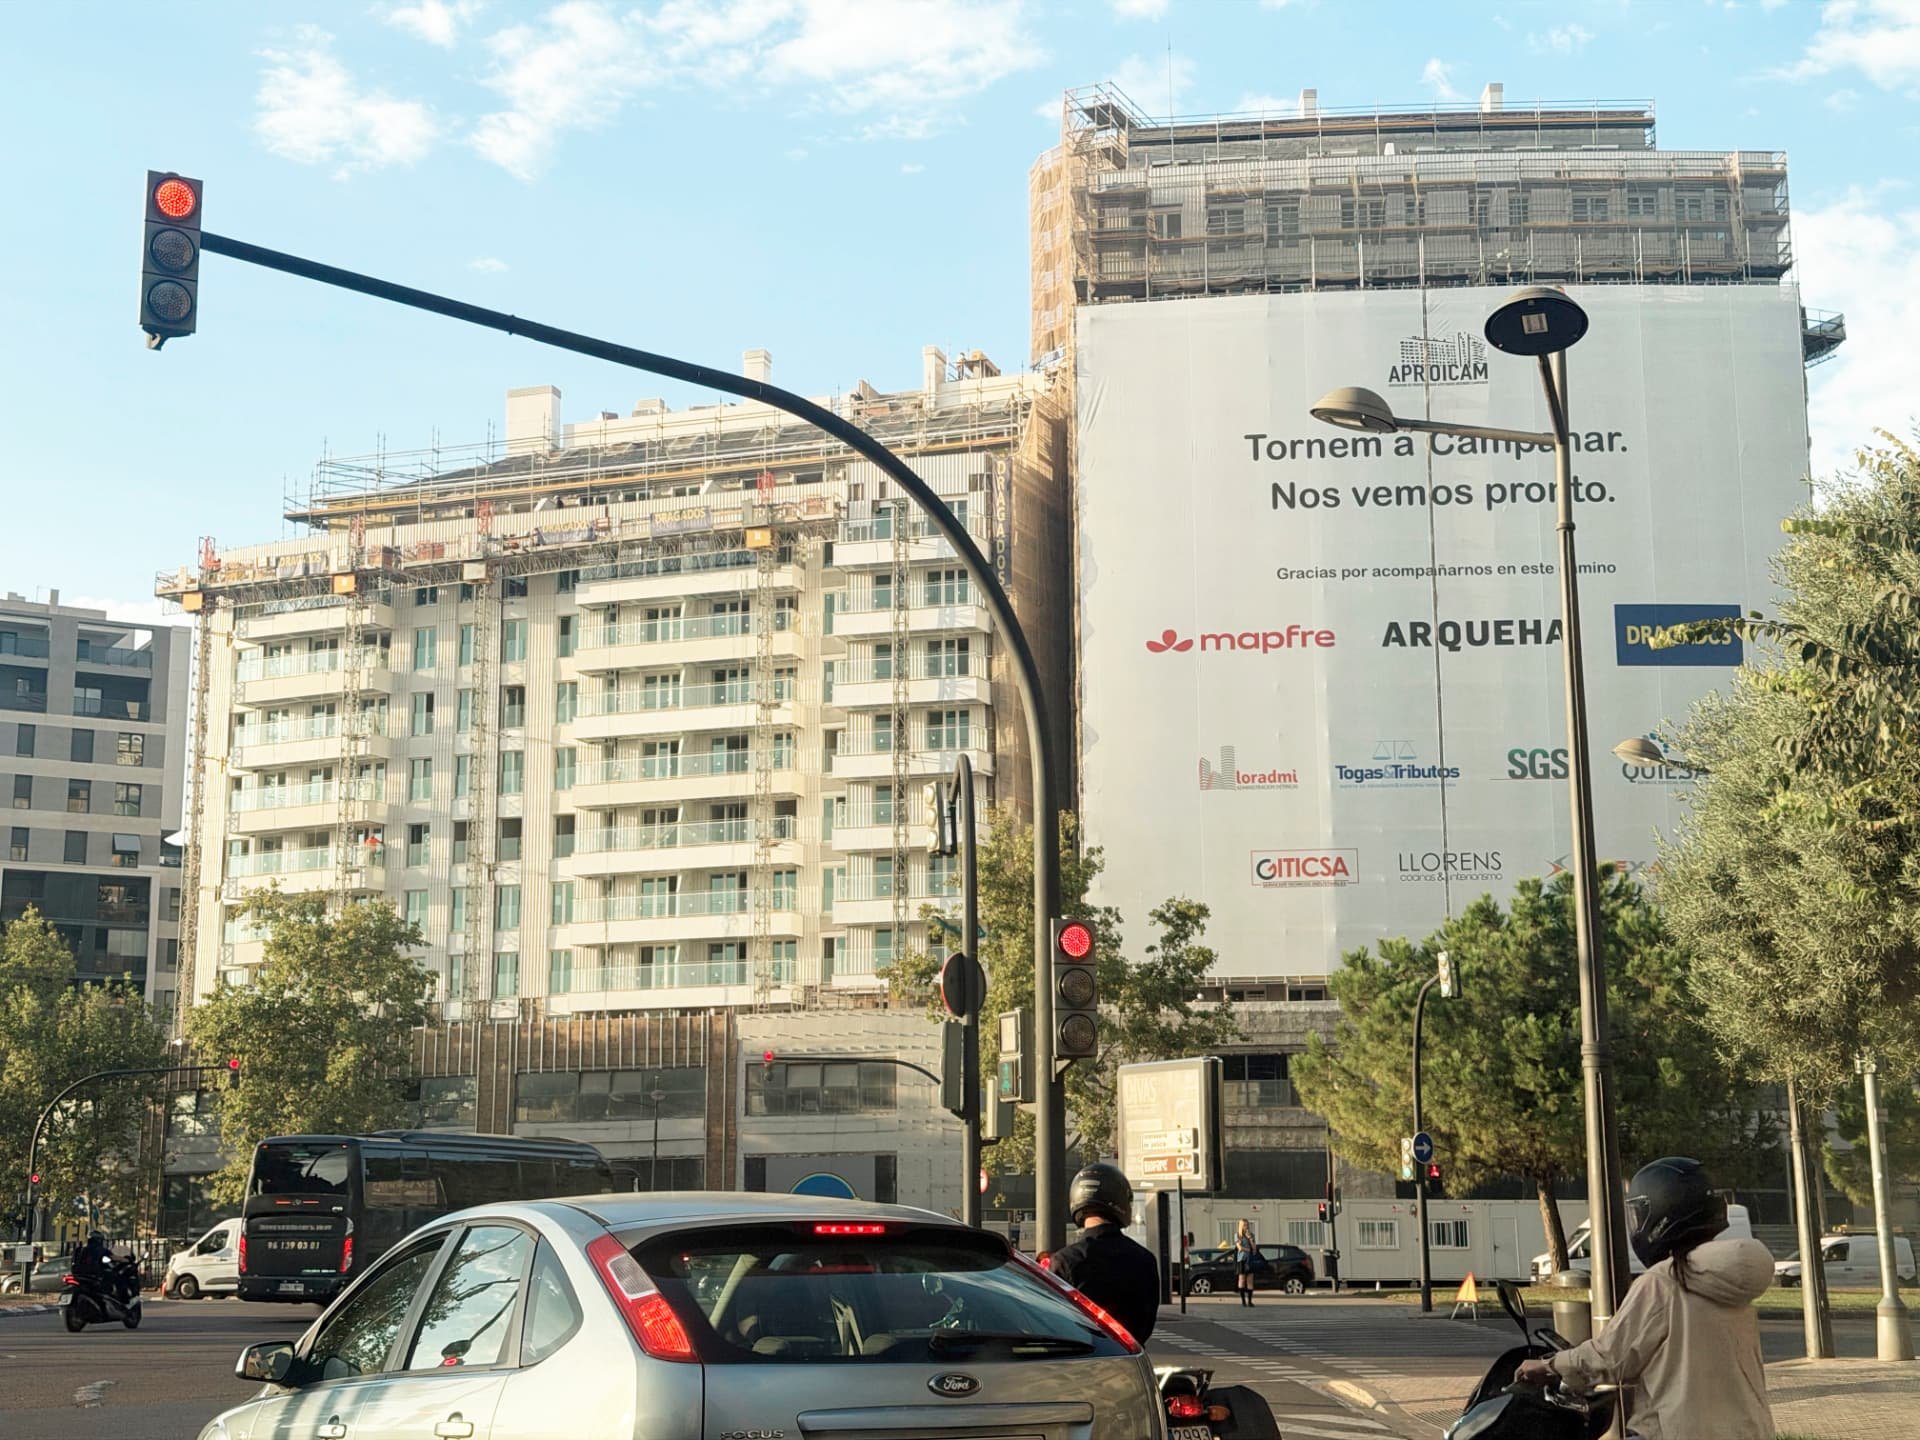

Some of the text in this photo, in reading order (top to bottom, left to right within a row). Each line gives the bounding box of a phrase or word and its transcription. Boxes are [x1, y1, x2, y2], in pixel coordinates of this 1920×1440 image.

[1388, 363, 1488, 382] APROICAM
[1244, 433, 1382, 461] Tornem
[1394, 436, 1414, 457] a
[1272, 481, 1341, 510] Nos
[1352, 484, 1473, 508] vemos
[655, 507, 706, 524] DRAGADOS
[996, 460, 1006, 585] DRAGADOS
[1277, 561, 1617, 581] Gracias por acompañarnos en este mino
[1200, 624, 1336, 654] mapfre
[1382, 619, 1563, 652] ARQUEHA
[1626, 617, 1733, 646] DRAOS
[1335, 764, 1460, 783] Togas&Tributos
[1508, 748, 1569, 780] SGS
[1236, 769, 1298, 784] loradmi
[1256, 856, 1350, 880] GITICSA
[1399, 851, 1502, 872] LLORENS
[1437, 872, 1445, 882] &
[1449, 872, 1503, 881] nteriorismo
[943, 1376, 970, 1390] Ford
[720, 1430, 785, 1440] FOCUS
